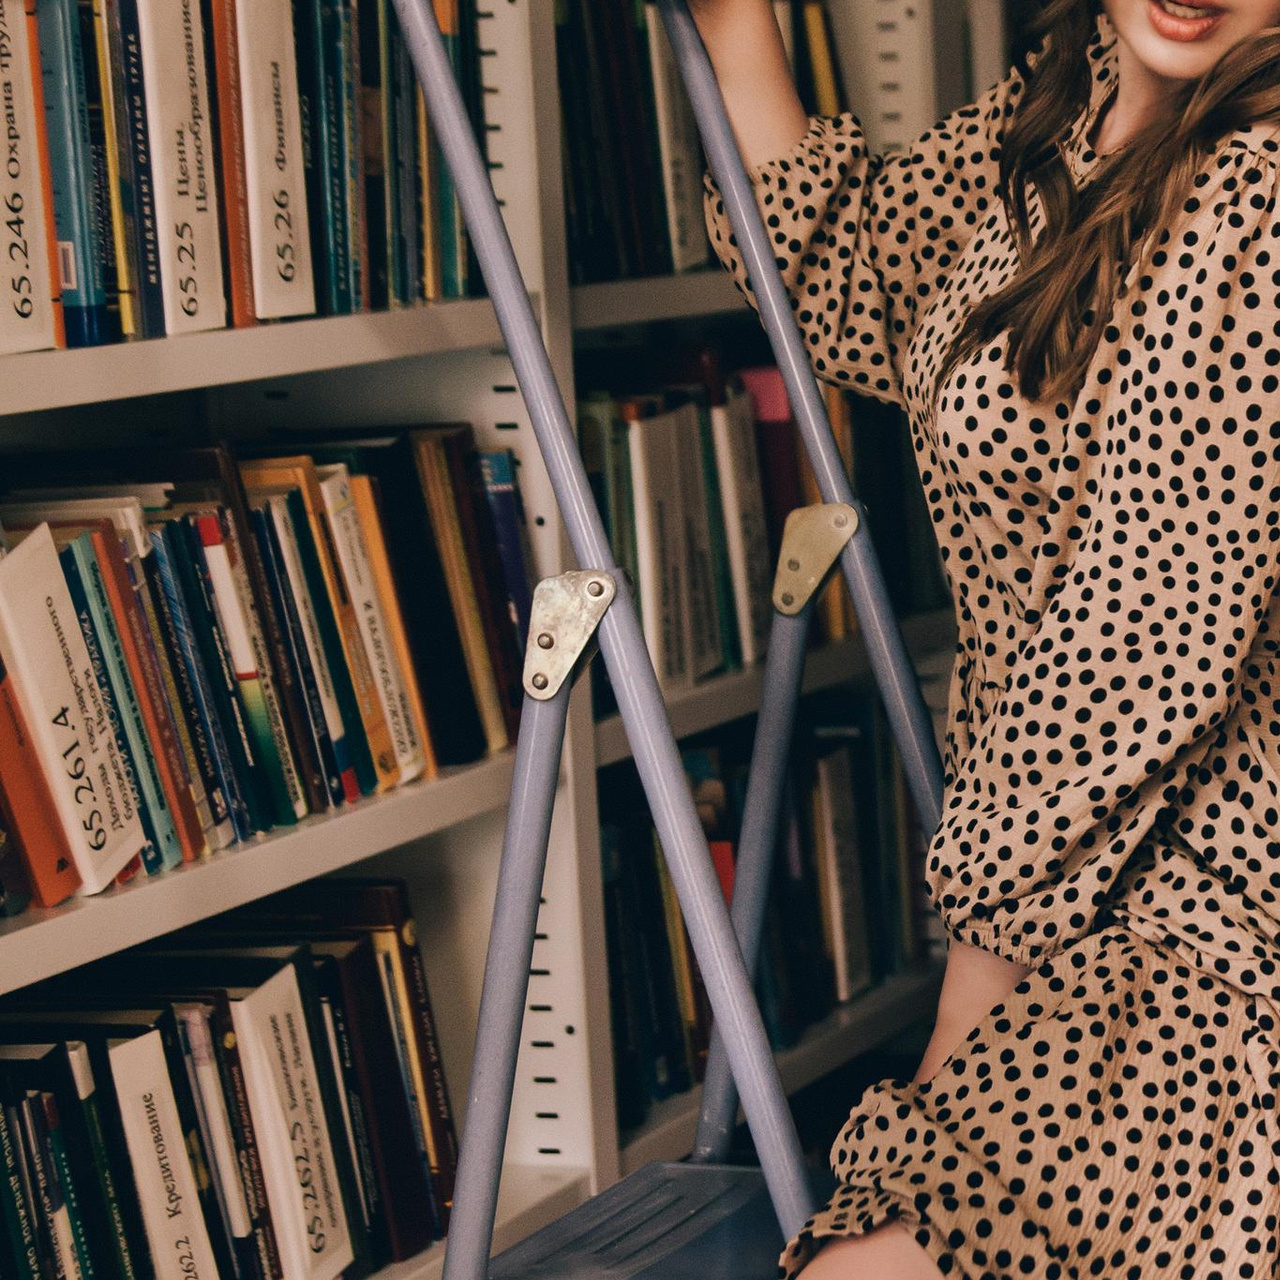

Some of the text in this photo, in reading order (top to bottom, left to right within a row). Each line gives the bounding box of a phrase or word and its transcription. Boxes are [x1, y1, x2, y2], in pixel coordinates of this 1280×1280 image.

[1, 80, 23, 178] Охрана
[128, 31, 157, 284] МЕНЕДЖМЕНТ ОХРАНЫ ТРУДА
[269, 60, 295, 281] 65.26 Финансы
[3, 189, 34, 319] 65.246
[174, 122, 199, 316] 65.25 Цены.
[42, 592, 124, 834] Доходы государственного
[75, 607, 102, 675] ПРАКТИКА
[48, 702, 109, 854] 65.261.4
[80, 665, 134, 823] бюджета. Налоги
[8, 1173, 32, 1246] ДЕНЕЖНОЕ
[139, 1087, 184, 1219] Кредитование
[267, 1011, 328, 1259] 65.262.5 Банковские
